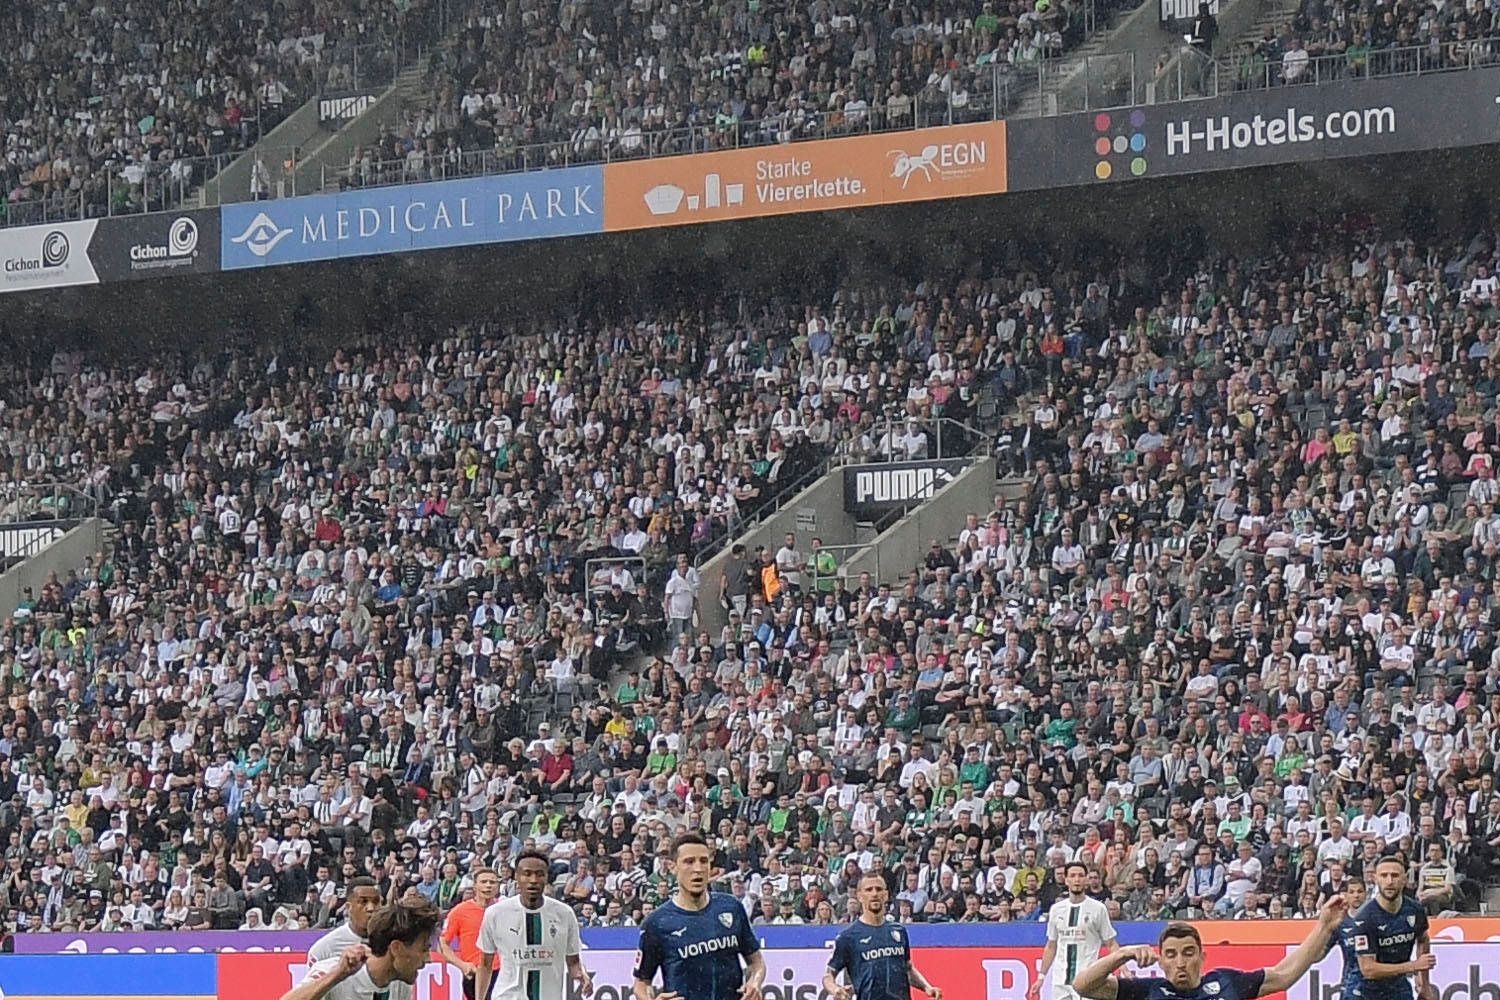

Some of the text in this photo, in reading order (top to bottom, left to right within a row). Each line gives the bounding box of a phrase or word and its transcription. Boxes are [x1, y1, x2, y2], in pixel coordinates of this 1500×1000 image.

[1166, 105, 1396, 156] H-Hotels.com
[940, 140, 986, 167] EGN
[756, 157, 812, 181] Starke
[756, 179, 867, 204] Viererkette.
[302, 184, 595, 244] MEDICAL PARK
[5, 257, 40, 272] Cichon
[130, 244, 167, 260] Cichon
[856, 467, 934, 503] PUMA
[0, 527, 53, 558] UMA
[677, 934, 739, 959] VONOVIA
